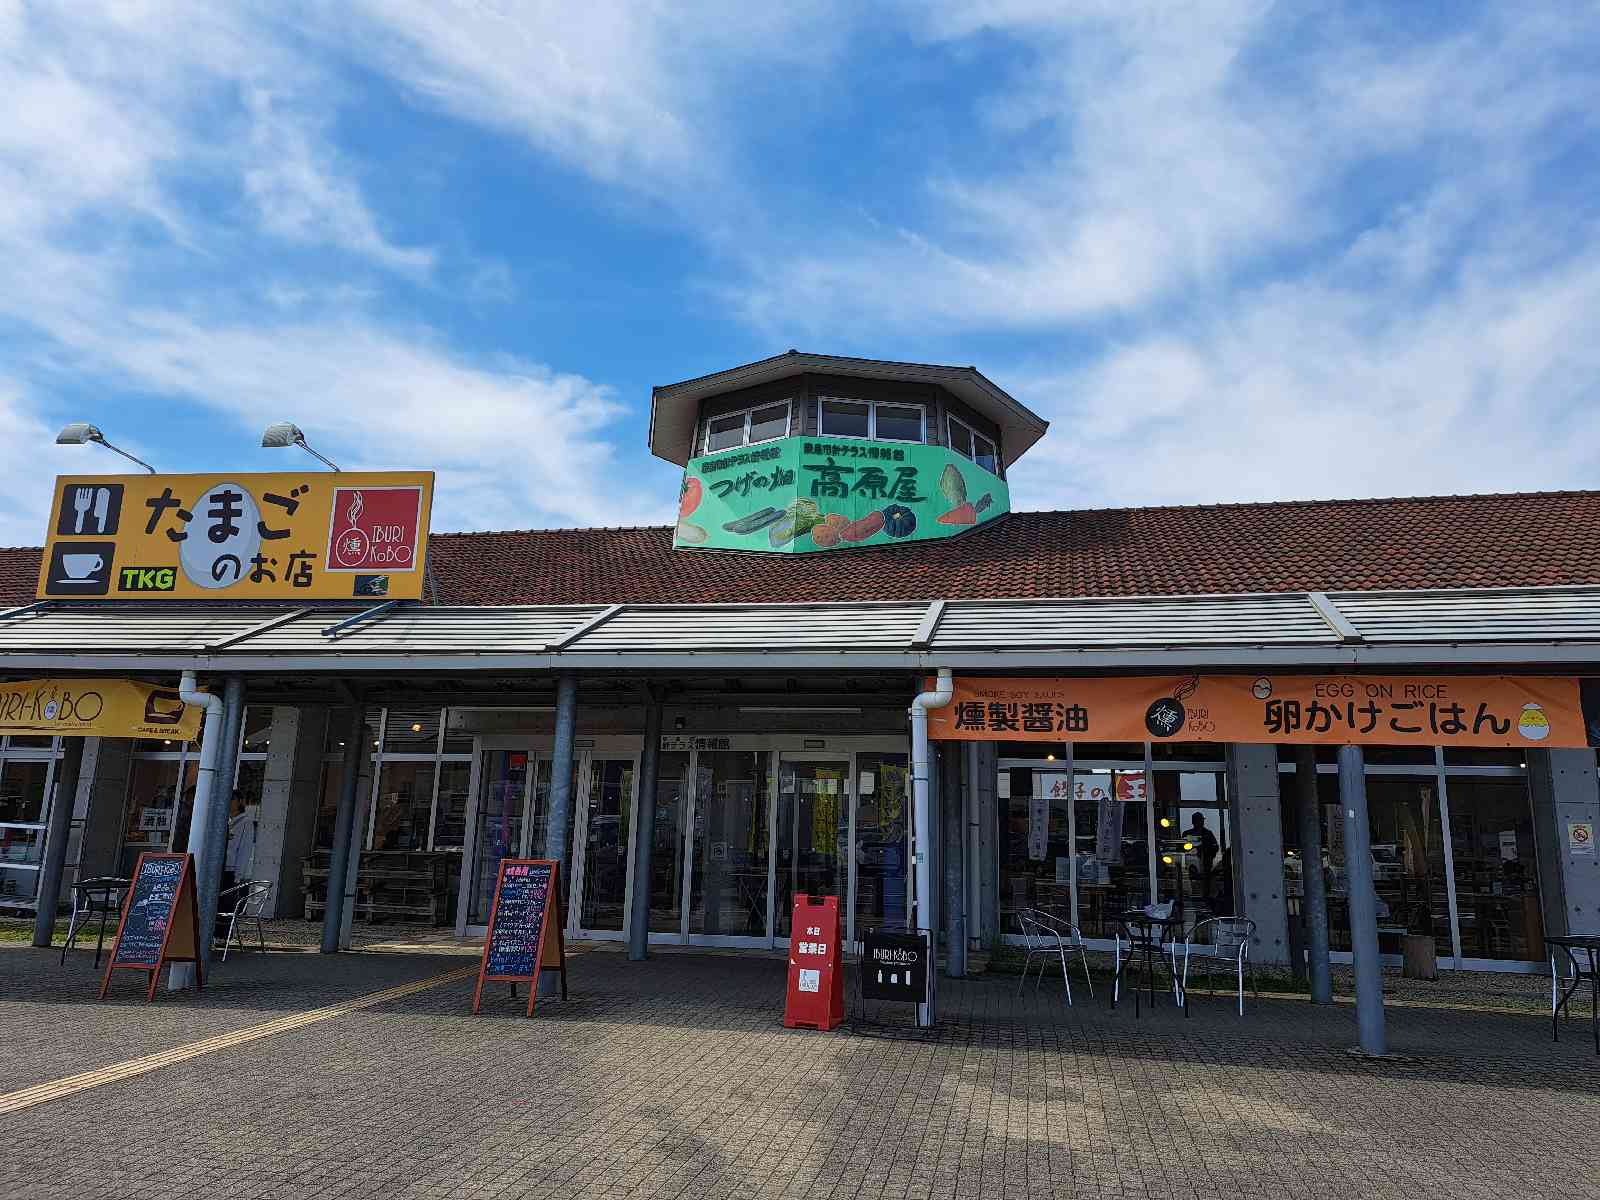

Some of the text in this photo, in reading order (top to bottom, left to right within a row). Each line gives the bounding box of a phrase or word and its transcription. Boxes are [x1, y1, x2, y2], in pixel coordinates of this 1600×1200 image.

[709, 464, 796, 499] つげの畑
[803, 457, 928, 503] 高原屋
[146, 484, 309, 543] たまご
[371, 525, 405, 543] IBURI
[123, 568, 175, 590] TKG
[212, 550, 317, 588] のお店
[1314, 683, 1449, 699] EGG ON RICE
[1263, 700, 1511, 735] 卵かけごはん
